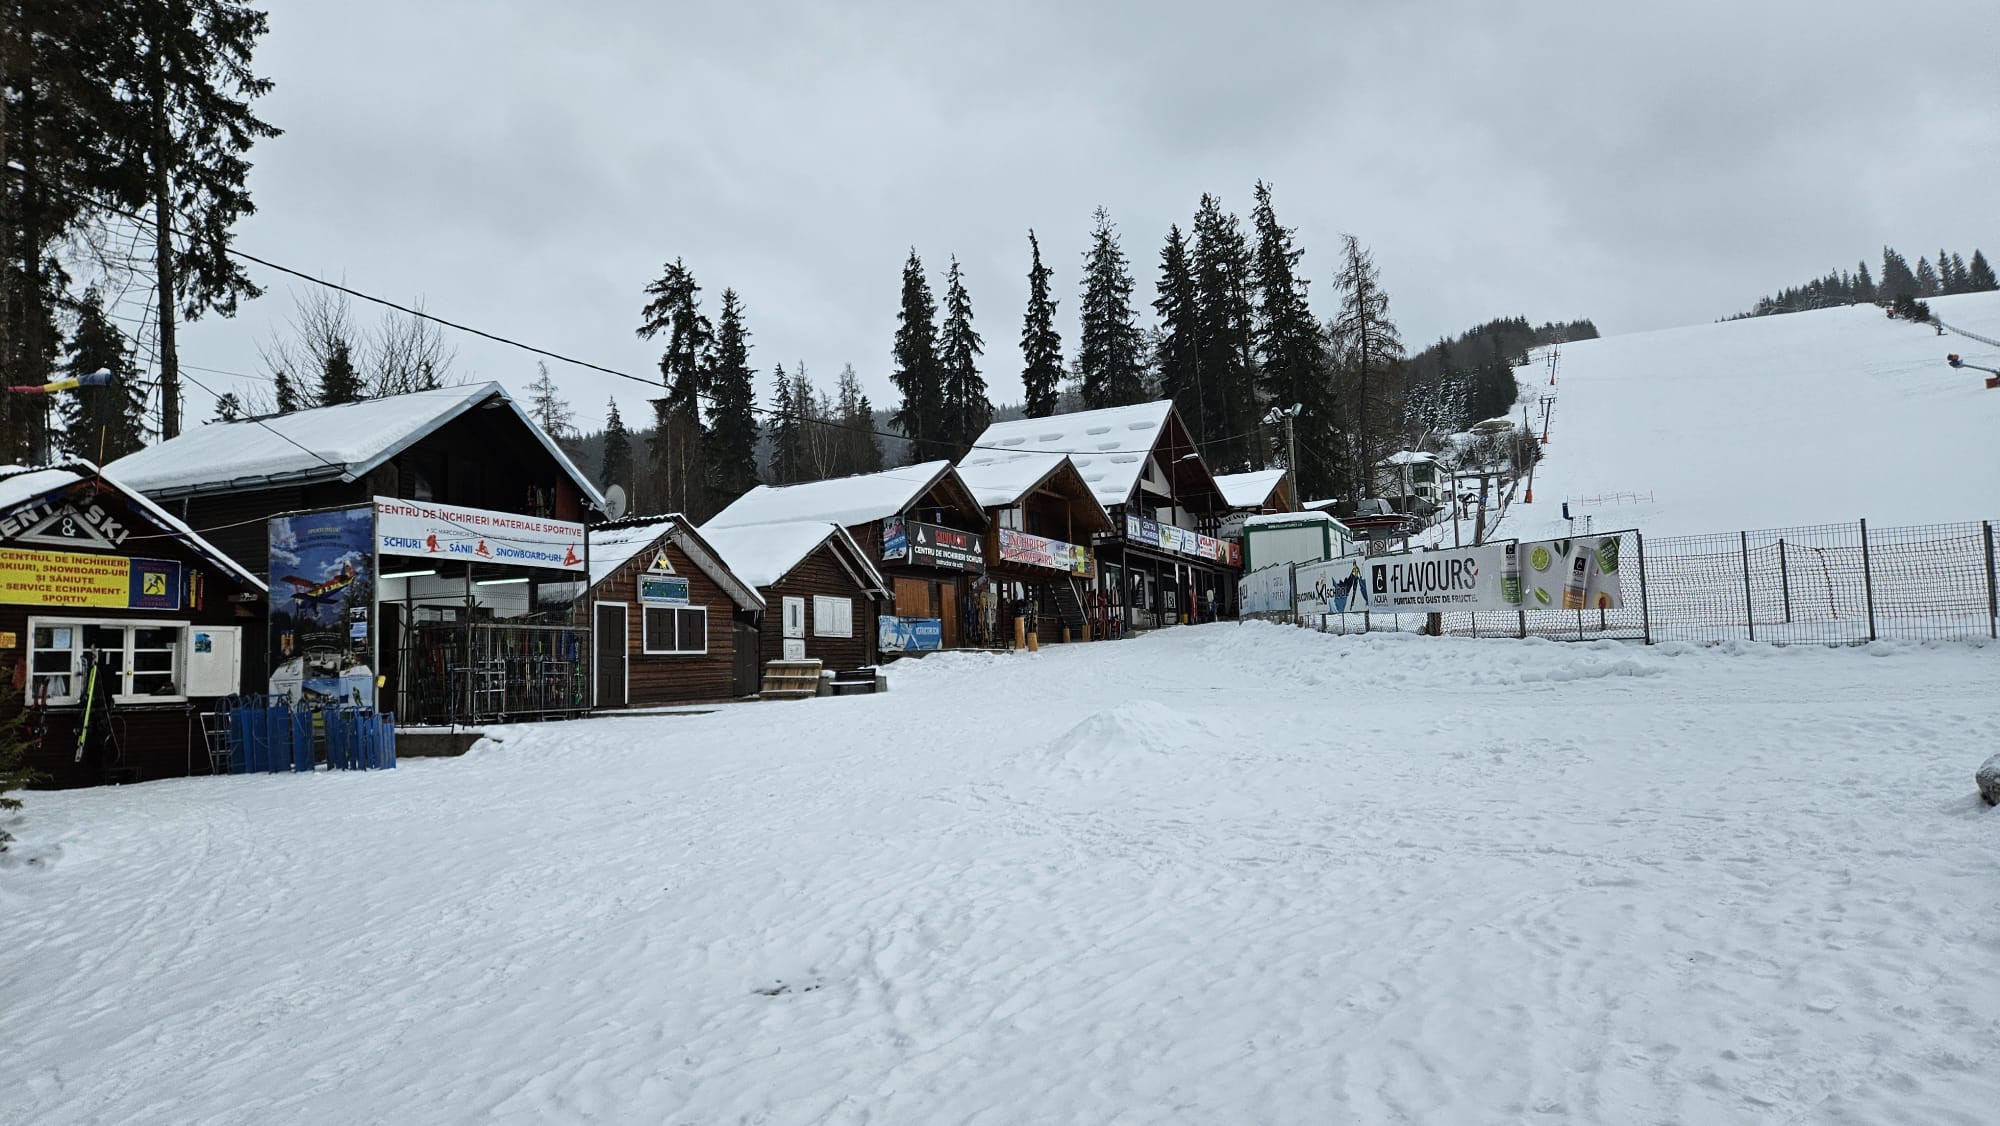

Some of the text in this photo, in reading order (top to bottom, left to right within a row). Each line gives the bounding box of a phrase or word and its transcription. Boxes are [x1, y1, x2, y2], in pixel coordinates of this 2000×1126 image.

[0, 503, 53, 541] EN
[61, 517, 76, 537] &
[84, 504, 130, 545] SKI
[378, 504, 419, 517] CENTRU
[422, 509, 436, 519] DE
[493, 518, 541, 532] MATERIALE
[543, 524, 582, 537] SPORTIVE
[1, 552, 52, 563] CENTRUL
[384, 537, 421, 549] SCHIURI
[496, 547, 561, 562] SNOWBOARD-URI
[914, 545, 935, 556] CENTRU
[935, 549, 943, 557] DE
[43, 565, 129, 577] SNOWBOARD-URI
[1393, 558, 1476, 593] FLAVOURS
[6, 583, 121, 595] SERVICE ECHIPAMENT
[42, 594, 88, 603] SPORTIV
[1393, 596, 1416, 605] PURITATE
[1416, 596, 1425, 604] CU
[1425, 595, 1441, 604] GUST
[1442, 595, 1451, 603] DE
